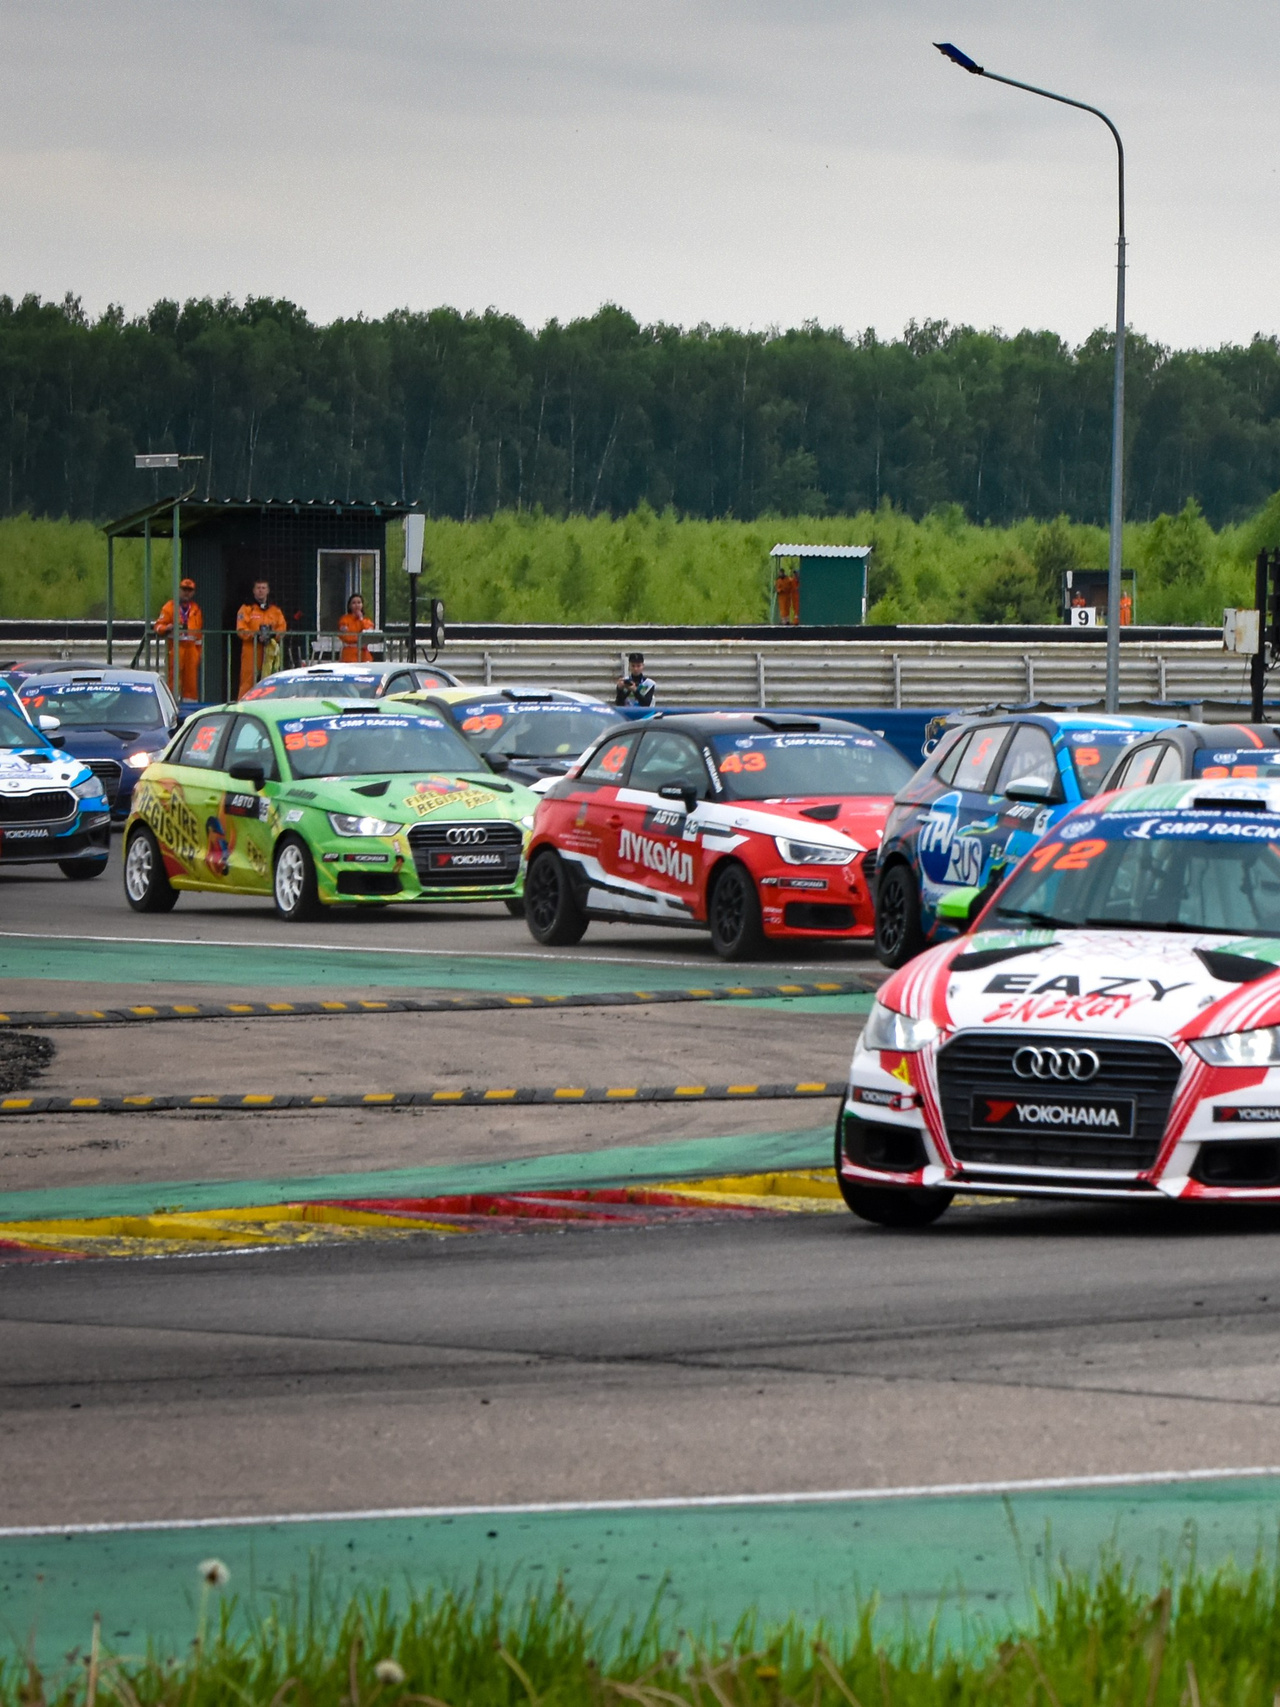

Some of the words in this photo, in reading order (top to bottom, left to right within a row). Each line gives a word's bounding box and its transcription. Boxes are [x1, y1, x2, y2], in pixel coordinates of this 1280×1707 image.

[1078, 610, 1089, 626] 9
[86, 685, 121, 693] RACING
[366, 720, 409, 728] RACING
[284, 730, 328, 750] 55
[601, 745, 629, 773] 43
[972, 738, 993, 766] 5
[1075, 748, 1100, 766] 5
[719, 752, 767, 773] 43
[140, 787, 196, 862] REGISTER
[170, 791, 199, 844] FIRE
[652, 810, 681, 827] АВТО
[686, 820, 698, 835] 43
[1038, 814, 1047, 828] 5
[4, 829, 49, 839] YOKOHAMA
[1155, 822, 1206, 836] SMP
[451, 854, 501, 865] YOKOHAMA
[618, 828, 693, 885] ЛУКОЙЛ
[1031, 839, 1107, 873] 12
[982, 973, 1195, 1002] EAZY
[983, 994, 1151, 1023] ENERGY
[1016, 1103, 1120, 1128] YOKOHAMA
